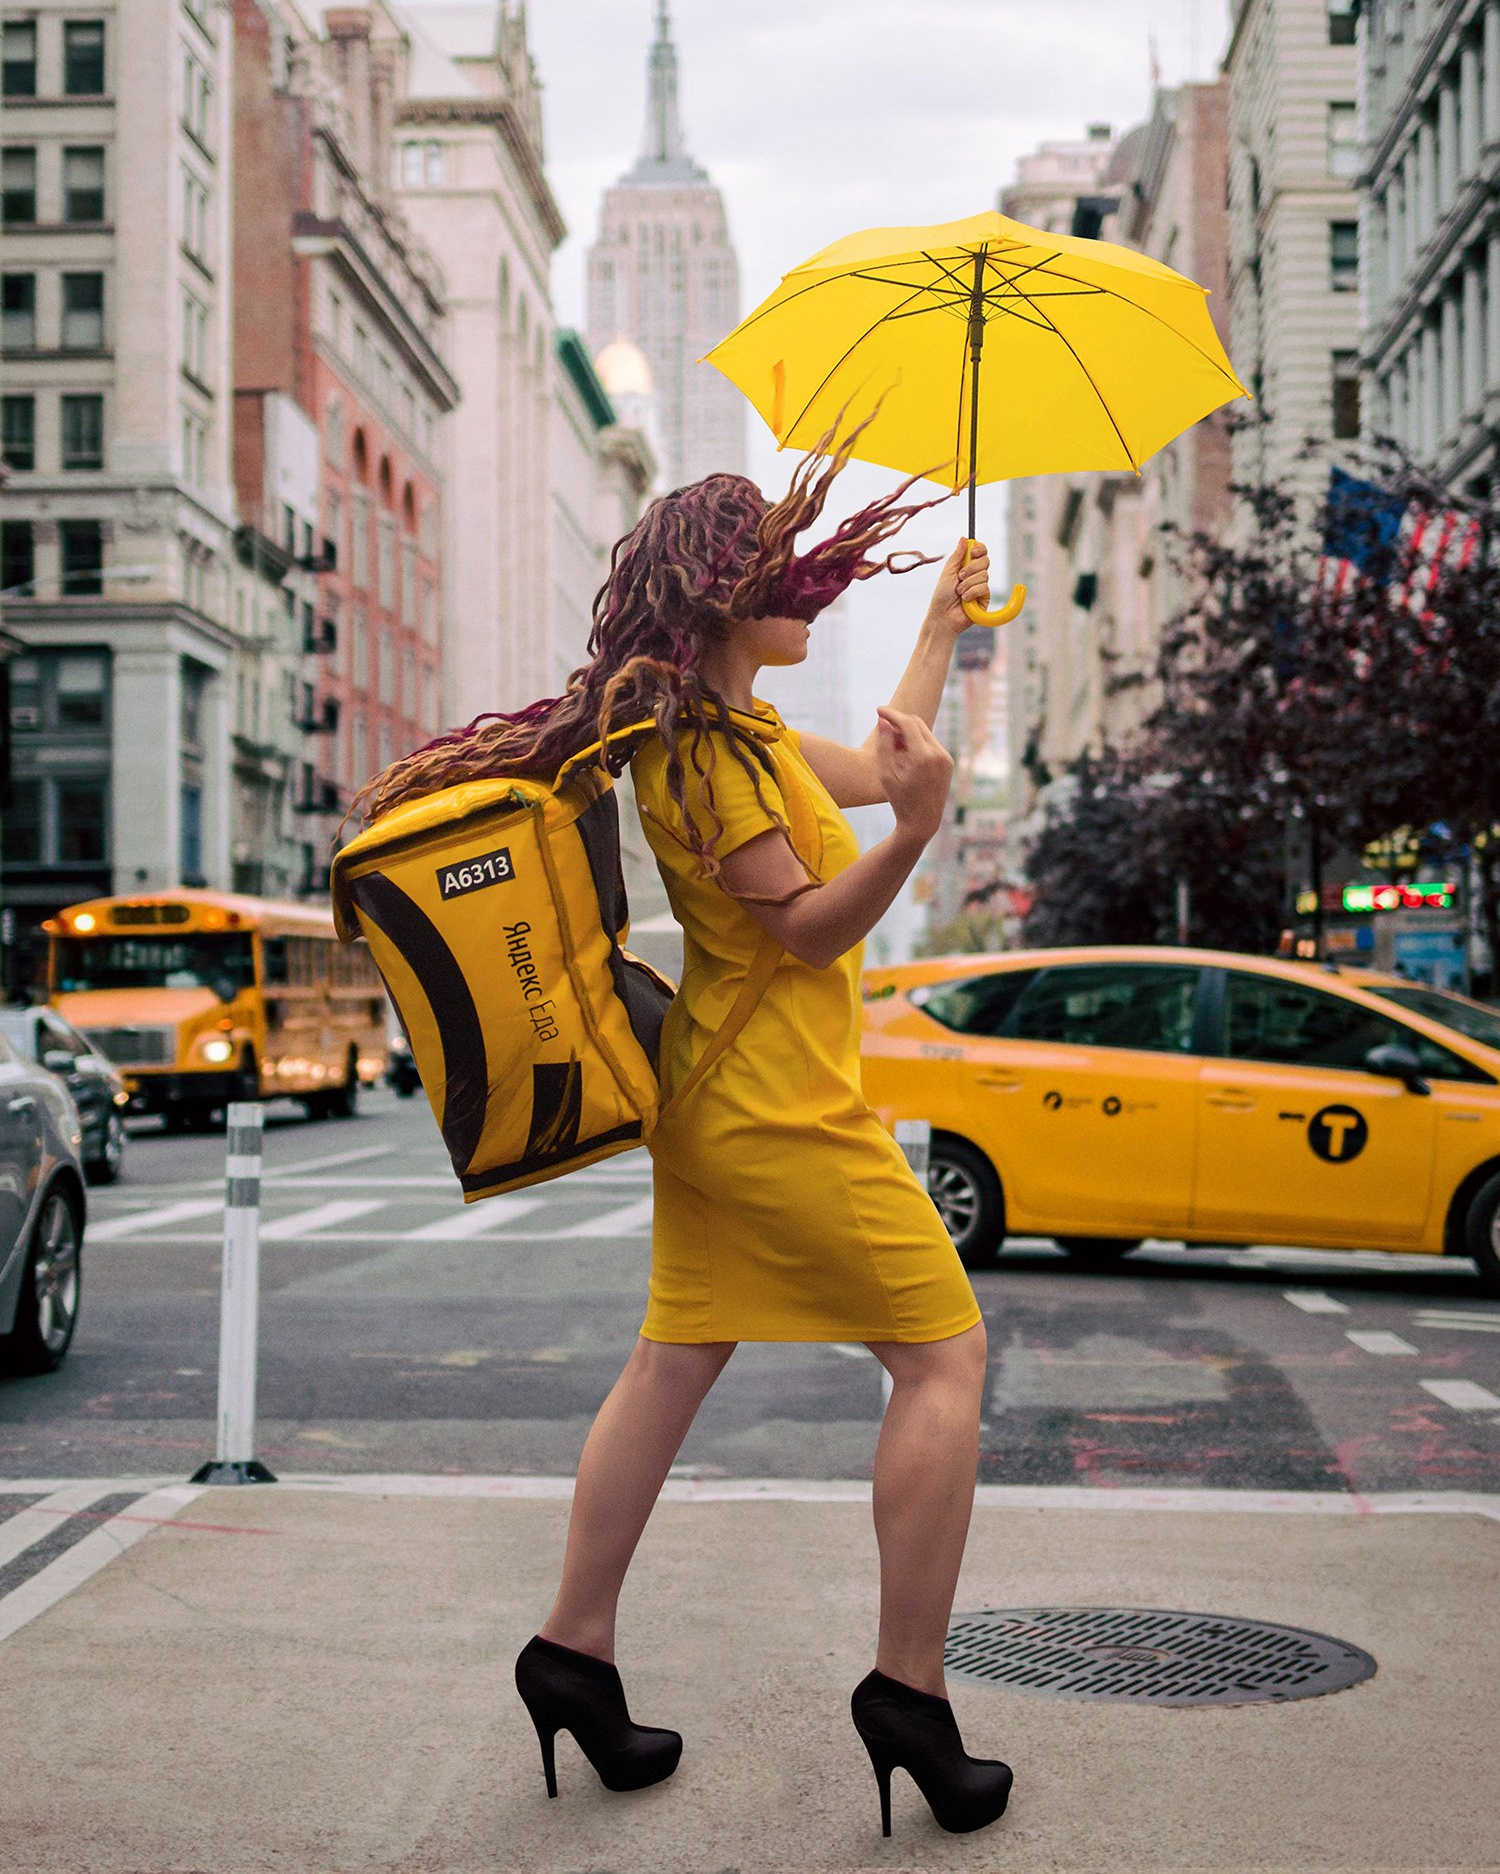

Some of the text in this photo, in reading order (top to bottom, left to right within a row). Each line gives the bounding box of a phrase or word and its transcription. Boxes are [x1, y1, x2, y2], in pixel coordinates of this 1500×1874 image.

[444, 856, 510, 894] A6313
[502, 921, 559, 1043] Яндекс Еда
[1321, 1112, 1358, 1158] T
